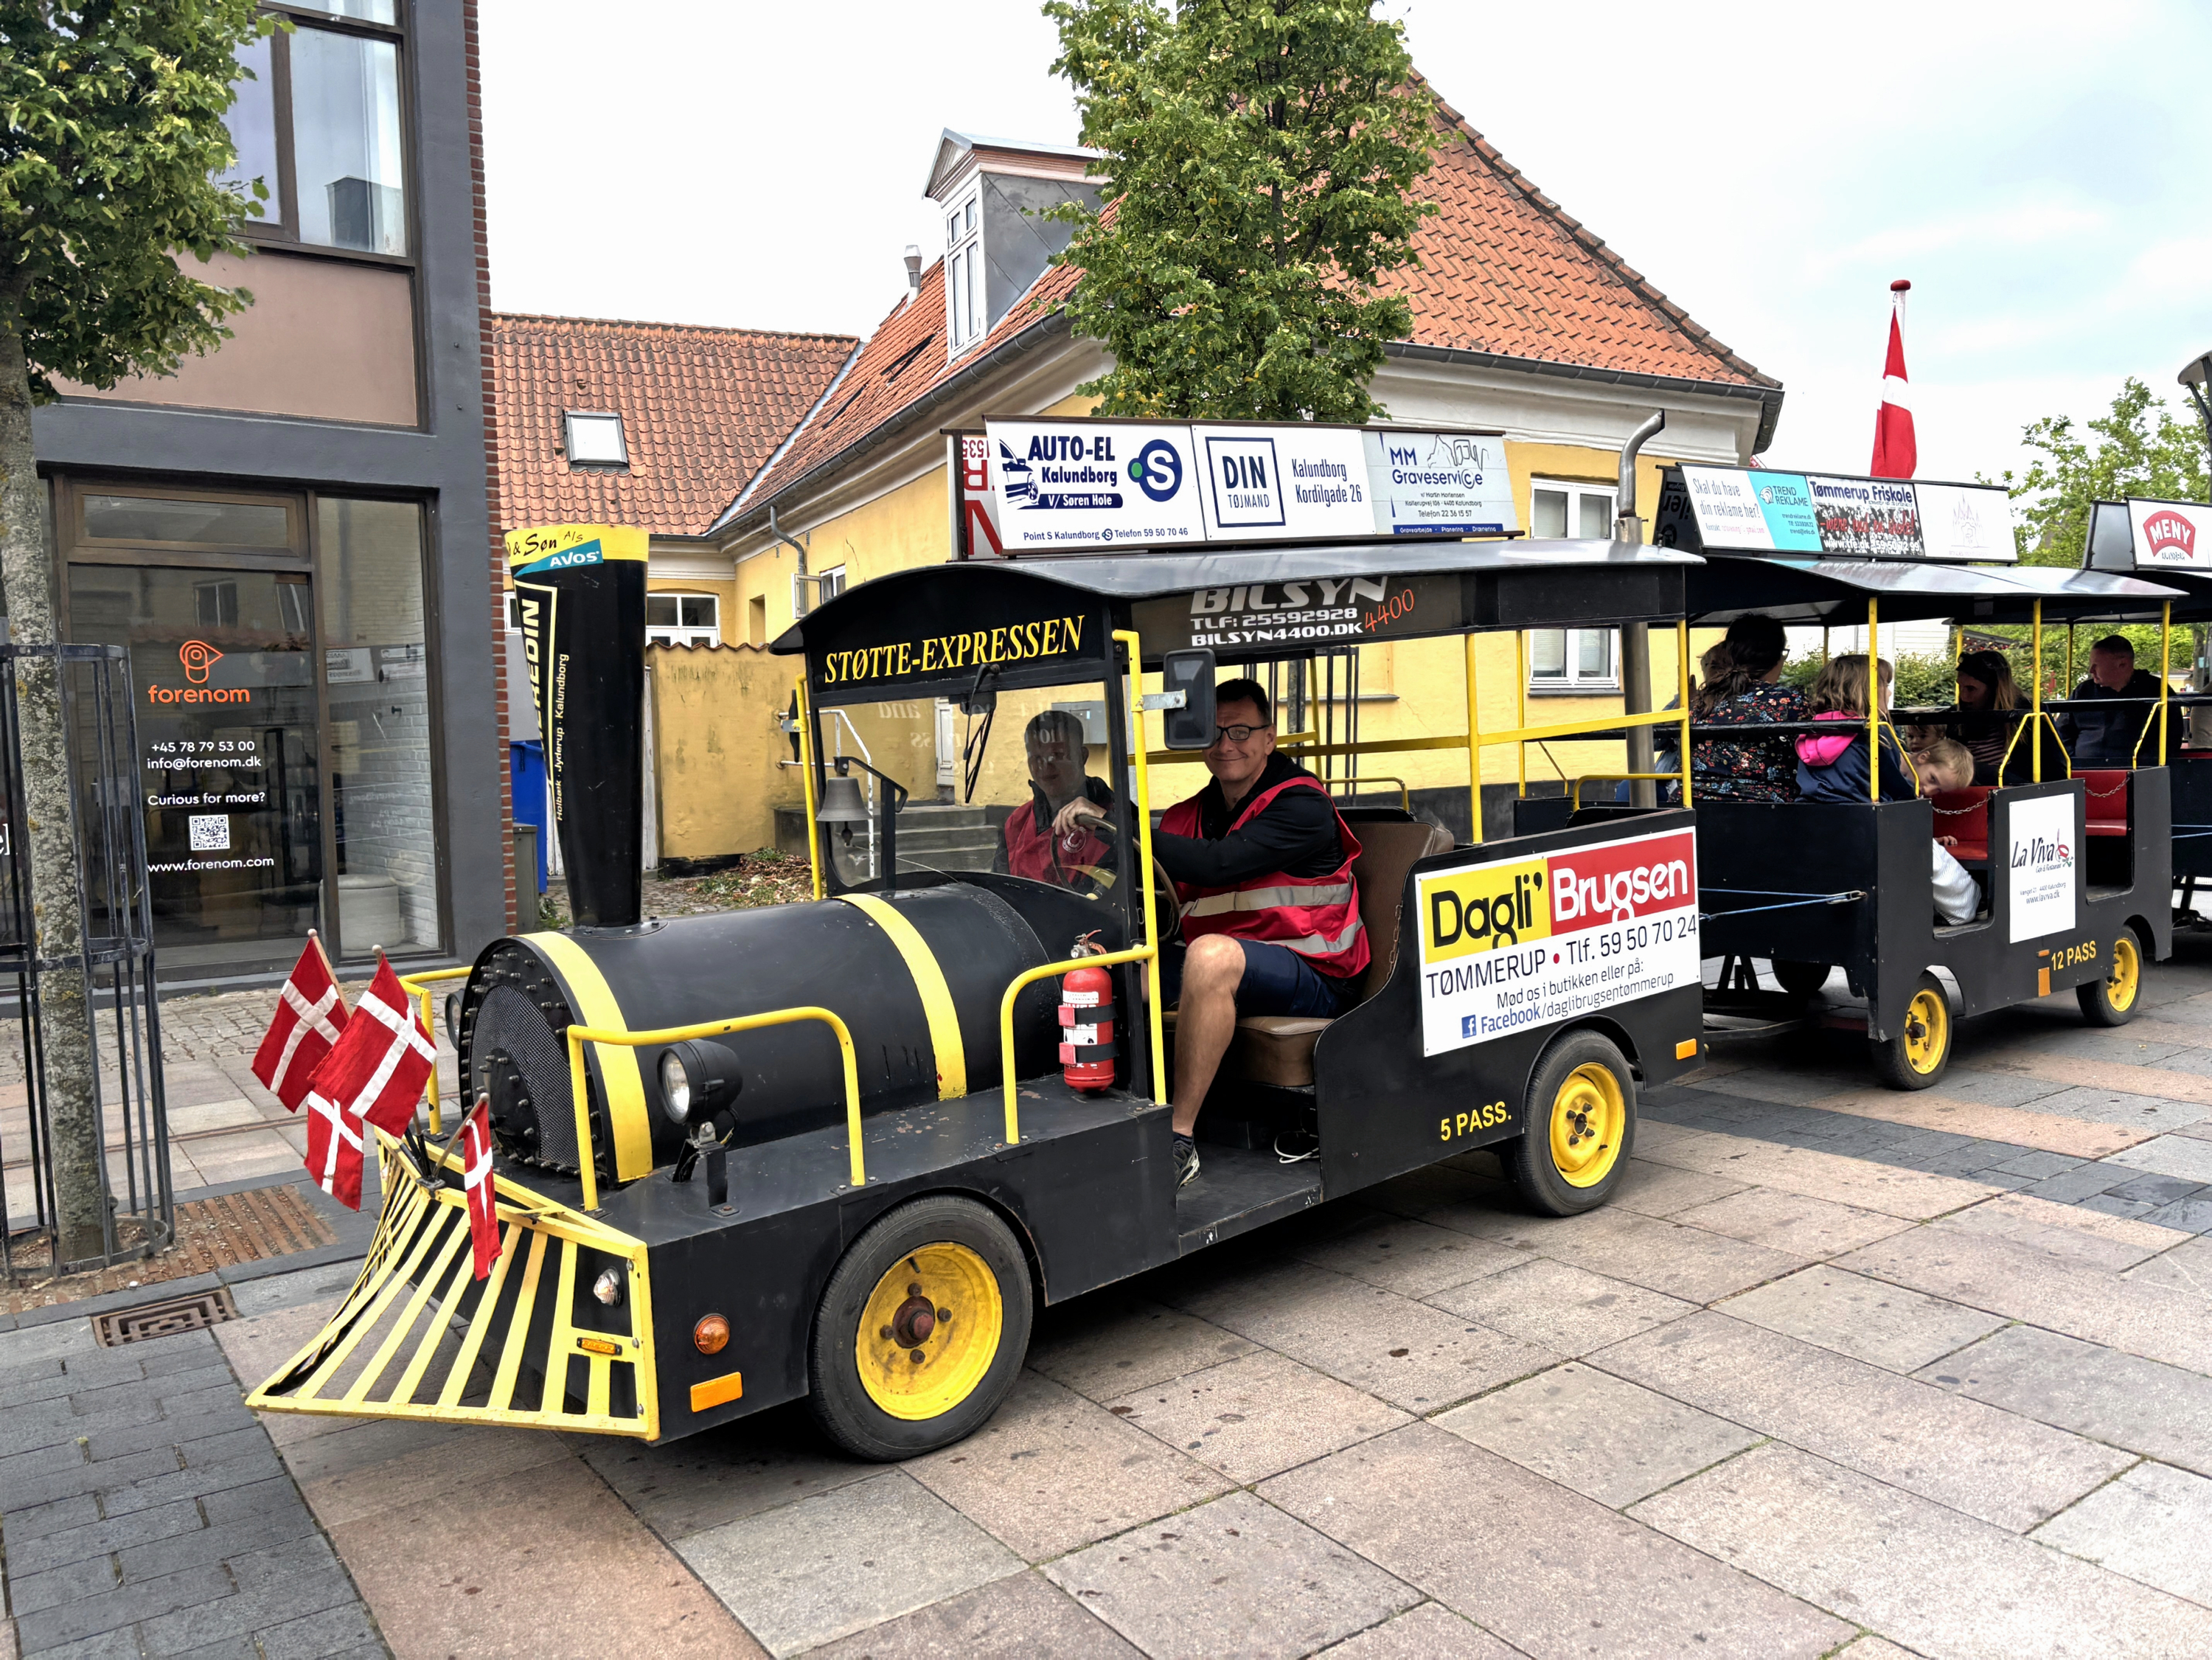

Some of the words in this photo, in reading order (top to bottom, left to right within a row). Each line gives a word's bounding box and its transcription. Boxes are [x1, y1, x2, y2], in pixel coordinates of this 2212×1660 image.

[1028, 435, 1116, 461] AUTO-EL
[1389, 447, 1417, 466] MM
[1042, 466, 1118, 487] Kalundborg
[1222, 455, 1267, 490] DIN
[1292, 459, 1348, 482] Kalundborg
[1295, 485, 1348, 507] Kordilgade
[1349, 484, 1363, 503] 26
[1693, 478, 1710, 495] Skal
[1711, 480, 1722, 496] du
[1722, 481, 1741, 497] have
[1773, 485, 1797, 496] TREND
[1810, 481, 1870, 504] Tømmerup
[1872, 485, 1913, 504] Friskole
[1062, 495, 1091, 507] Søren
[1092, 495, 1113, 506] Hole
[1227, 493, 1270, 510] TØJMAND
[1700, 499, 1713, 515] din
[1714, 501, 1743, 518] reklame
[1743, 503, 1761, 518] her?
[1775, 496, 1809, 507] REKLAME
[1418, 510, 1441, 518] Telefon
[1023, 531, 1046, 541] Point
[1048, 532, 1053, 540] S
[1054, 530, 1100, 541] Kalundborg
[1114, 529, 1142, 539] Telefon
[1144, 529, 1154, 537] 59
[1155, 528, 1166, 537] 50
[1167, 527, 1178, 536] 70
[1178, 527, 1189, 536] 46
[2149, 518, 2191, 545] MENY
[513, 541, 521, 554] &
[523, 533, 557, 557] Søn
[563, 531, 583, 543] A/S
[549, 552, 598, 568] AVOS
[1190, 576, 1388, 614] BILSYN
[1190, 616, 1238, 631] TLF:
[1242, 607, 1358, 627] 25592928
[1365, 588, 1414, 633] 4400
[1192, 622, 1364, 647] BILSYN4400.DK
[824, 614, 1085, 684] STØTTE-EXPRESSEN
[147, 684, 251, 703] forenom
[554, 653, 570, 719] Kalundborg
[151, 743, 176, 753] +45
[179, 742, 195, 752] 78
[198, 742, 215, 752] 79
[218, 741, 234, 752] 53
[237, 740, 255, 751] 00
[554, 727, 565, 772] Jyderup
[147, 756, 262, 770] info@forenom.dk
[147, 794, 199, 806] Curious
[203, 793, 221, 805] for
[225, 792, 265, 804] more?
[147, 857, 274, 872] www.forenom.com
[2011, 841, 2028, 869] La
[2031, 837, 2055, 866] Viva
[1553, 859, 1688, 923] Brugsen
[1426, 948, 1546, 998] TØMMERUP
[1566, 940, 1596, 965] Tlf.
[1600, 932, 1621, 957] 59
[1627, 925, 1648, 951] 50
[1652, 920, 1672, 945] 70
[1677, 914, 1697, 939] 24
[2051, 951, 2065, 971] 12
[2067, 940, 2096, 967] PASS
[1498, 990, 1524, 1009] Mød
[1527, 988, 1540, 1001] os
[1543, 982, 1547, 997] i
[1549, 971, 1599, 996] butikken
[1601, 963, 1625, 984] eller
[1627, 957, 1644, 979] på:
[1440, 1118, 1451, 1141] 5
[1456, 1101, 1512, 1136] PASS.
